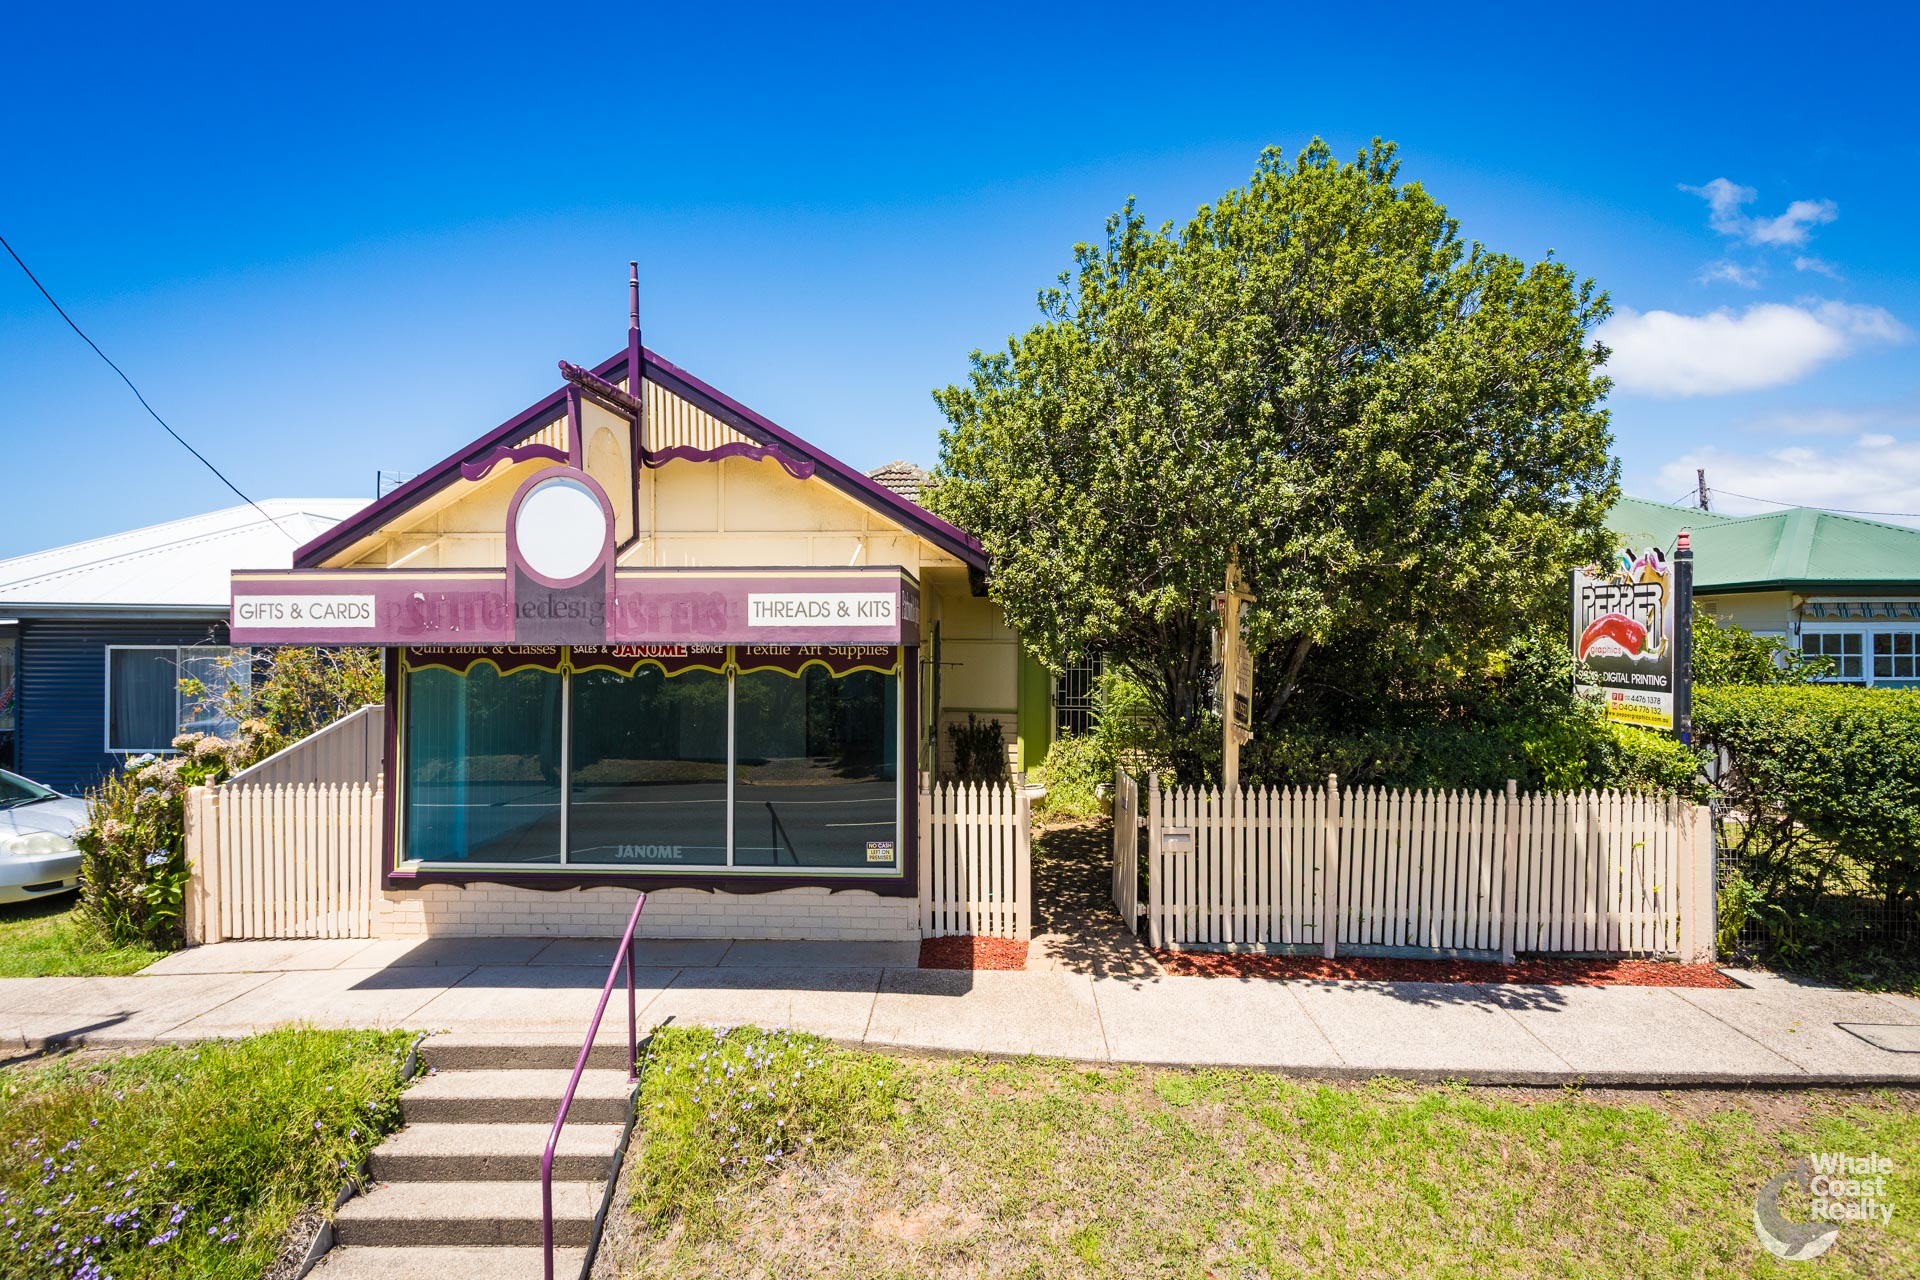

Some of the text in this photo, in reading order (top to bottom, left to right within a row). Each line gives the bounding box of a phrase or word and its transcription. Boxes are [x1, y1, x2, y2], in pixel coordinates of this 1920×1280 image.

[239, 602, 370, 620] GIFTS & CARDS
[753, 600, 831, 619] THREADS
[836, 600, 850, 618] &
[857, 600, 891, 618] KITS
[1582, 582, 1663, 648] PEPPER
[492, 646, 504, 655] &
[508, 645, 557, 655] Classes
[573, 644, 723, 658] SALES & JANOME SERVICE
[798, 645, 822, 656] Art
[829, 645, 889, 660] Supplies
[1591, 646, 1622, 655] graphics
[1603, 671, 1630, 684] DIGITAL
[1631, 673, 1667, 687] PRINTING
[1631, 694, 1646, 703] 4476
[1647, 696, 1661, 705] 1378
[1619, 703, 1637, 712] 0404
[1639, 705, 1649, 714] 776
[1651, 707, 1661, 716] 132
[614, 844, 683, 859] JANOME
